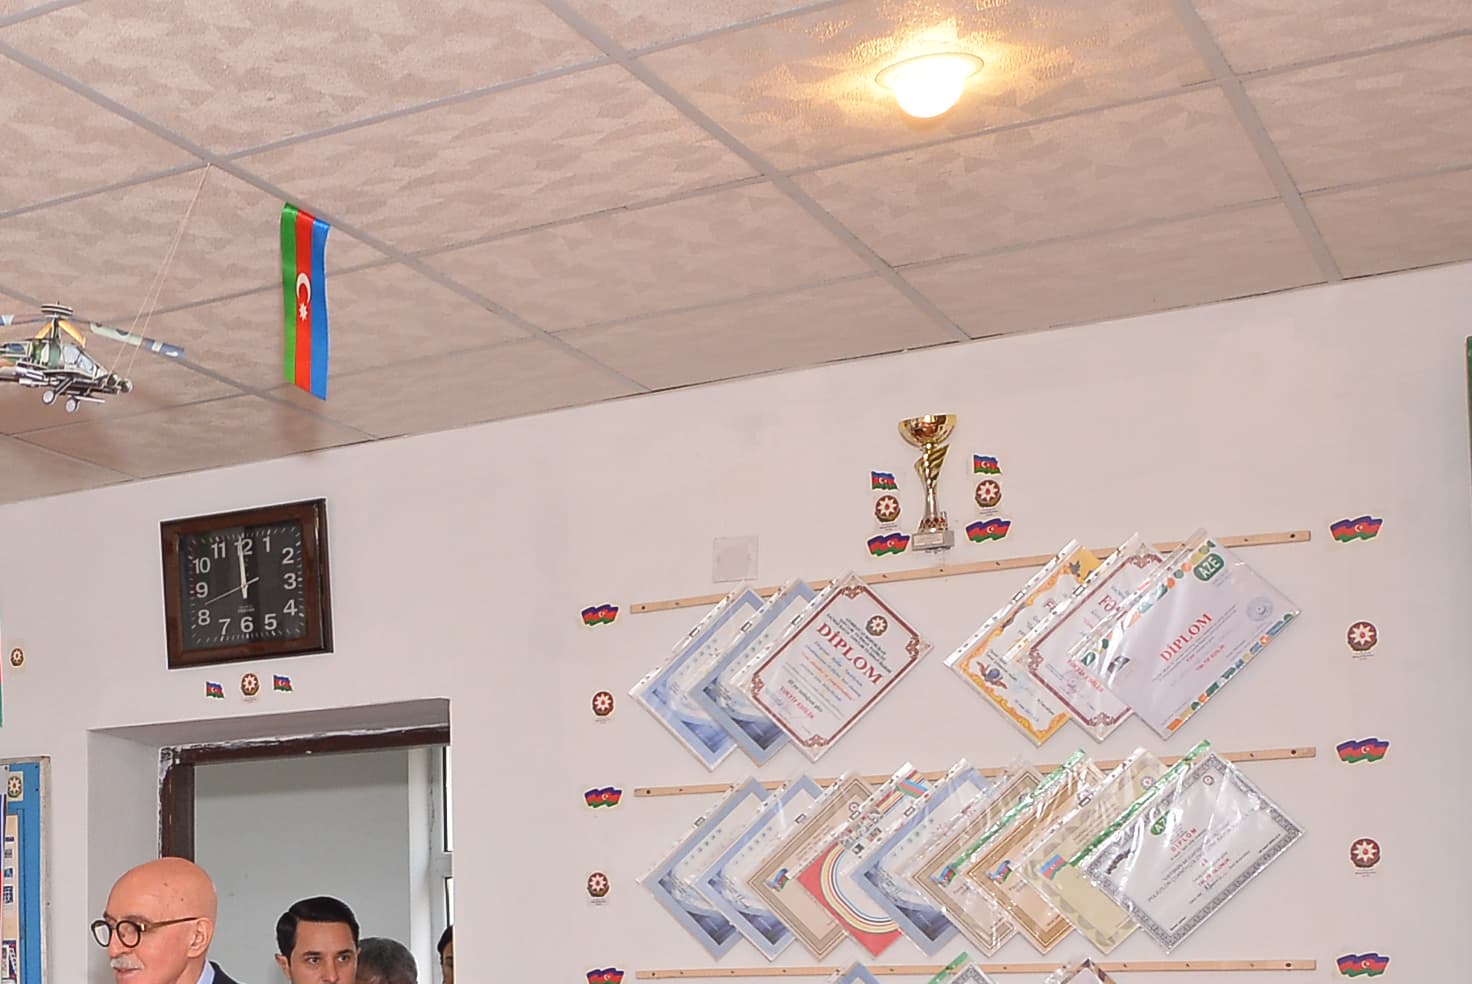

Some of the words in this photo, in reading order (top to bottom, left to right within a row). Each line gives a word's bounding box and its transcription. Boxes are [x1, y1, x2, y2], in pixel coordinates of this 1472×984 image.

[211, 542, 226, 559] 11
[263, 536, 271, 552] 1
[282, 547, 295, 564] 2
[193, 557, 211, 574] 10
[1197, 556, 1223, 579] AZE
[284, 573, 297, 589] 3
[196, 582, 209, 598] 9
[283, 599, 298, 616] 4
[198, 609, 210, 626] 8
[240, 617, 254, 633] 6
[264, 613, 277, 630] 5
[219, 618, 231, 636] 7
[816, 622, 883, 685] DİPLOM
